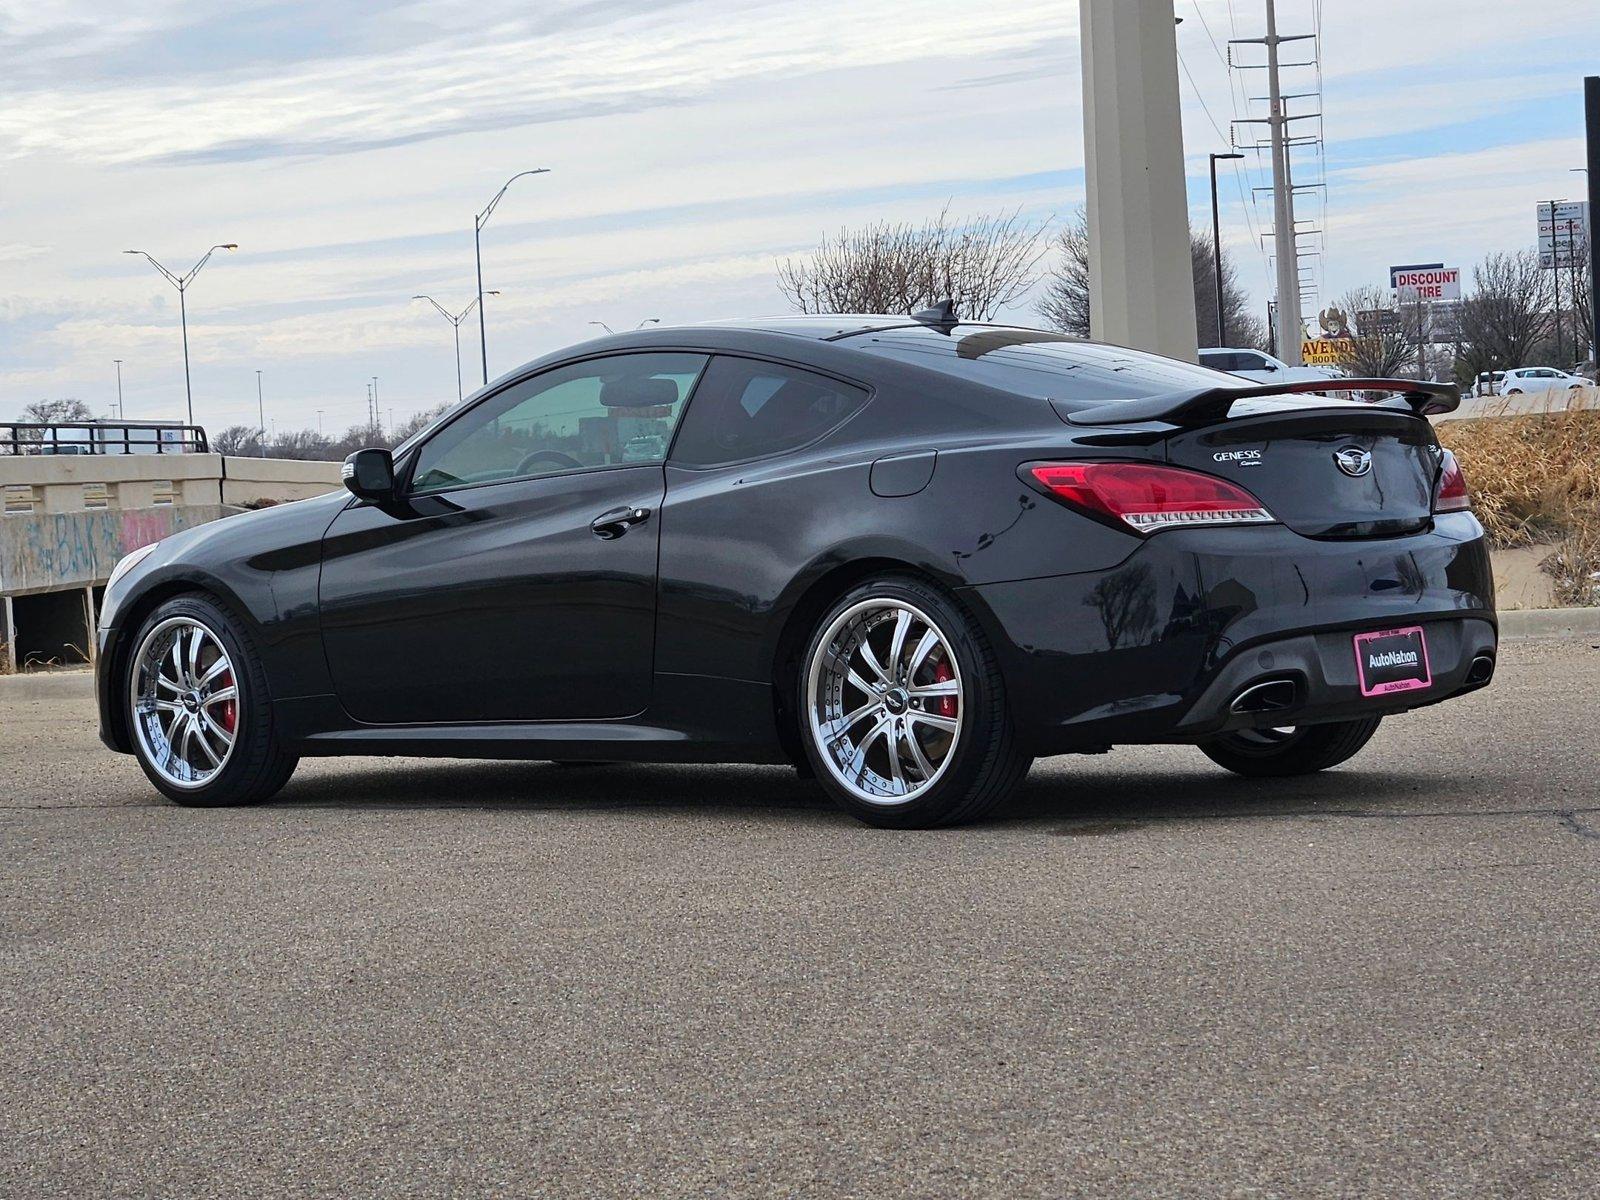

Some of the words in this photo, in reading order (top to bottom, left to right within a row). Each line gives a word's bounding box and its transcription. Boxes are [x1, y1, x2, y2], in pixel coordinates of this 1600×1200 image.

[1399, 271, 1457, 285] DISCOUNT
[1416, 286, 1442, 298] TIRE
[1312, 355, 1336, 364] BOOT
[1213, 450, 1261, 461] GENESIS
[1369, 650, 1417, 668] AutoNation
